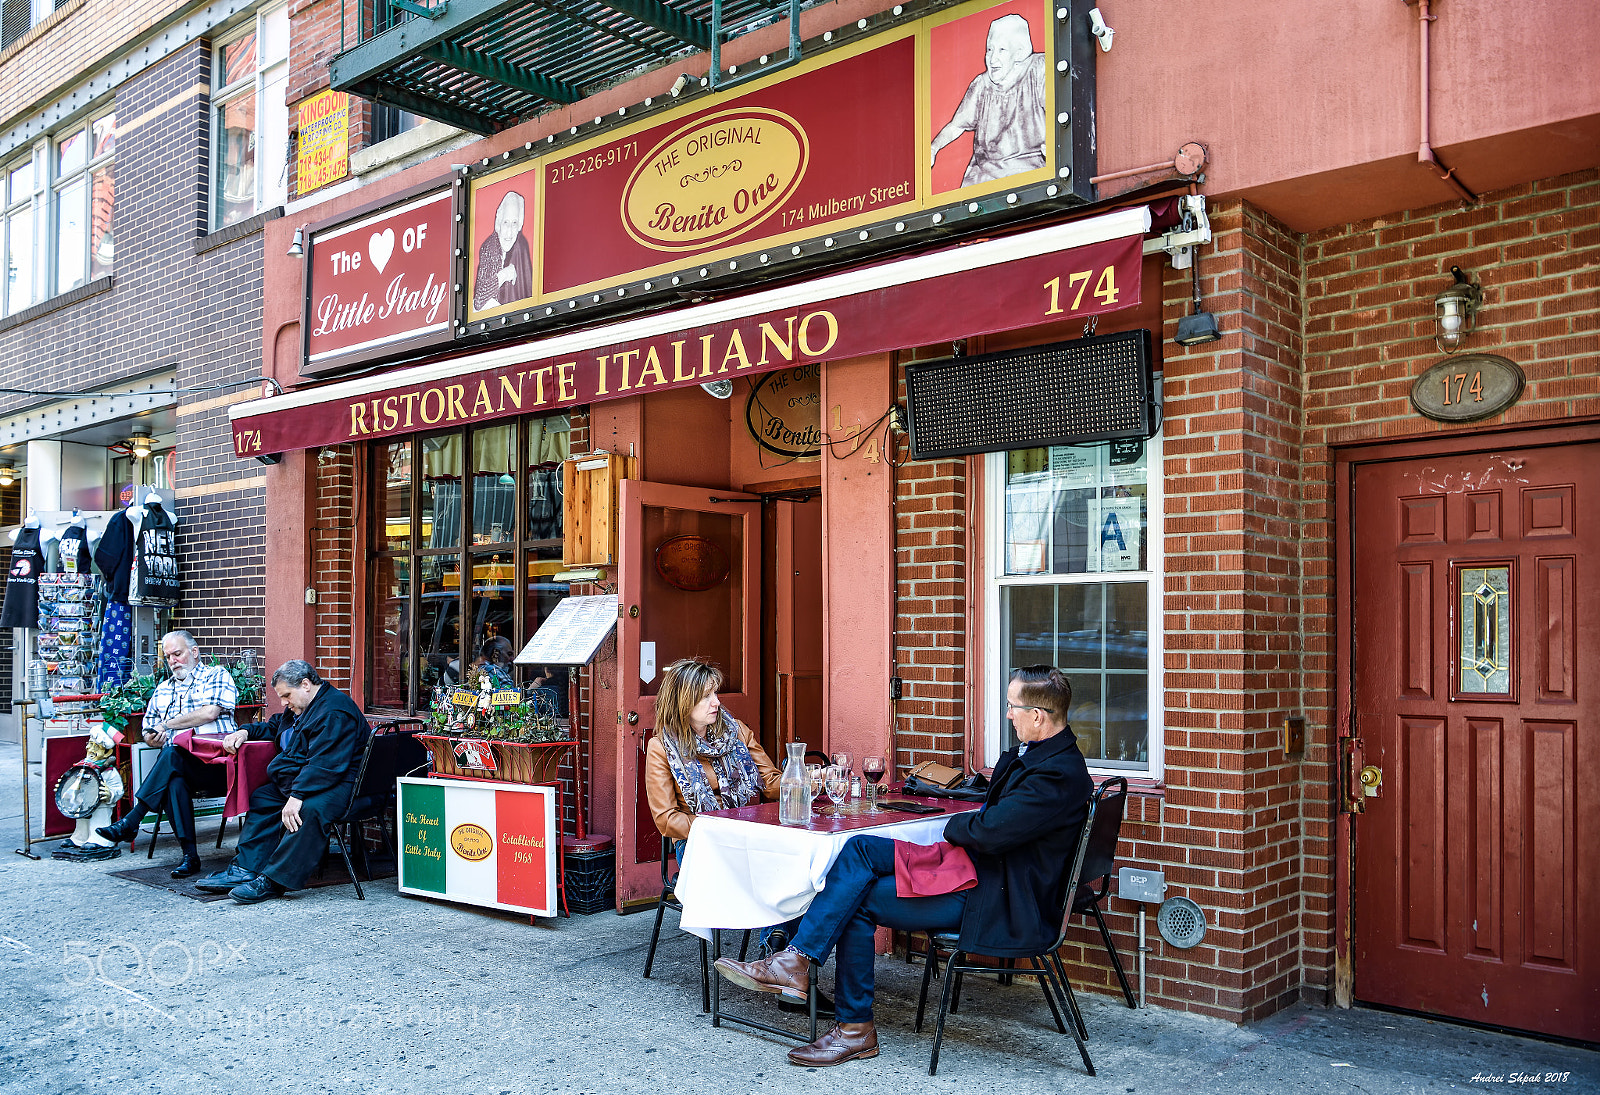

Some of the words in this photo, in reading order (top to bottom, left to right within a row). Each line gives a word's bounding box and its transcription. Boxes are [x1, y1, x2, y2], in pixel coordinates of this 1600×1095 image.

[300, 91, 347, 127] KINGDOM
[300, 109, 347, 137] WATERPROOFING
[307, 125, 333, 143] ROOFING
[551, 141, 639, 185] 212-226-9171
[655, 152, 681, 177] THE
[686, 126, 762, 157] ORIGINAL
[648, 202, 729, 233] Benito
[733, 172, 780, 215] One
[781, 210, 805, 228] 174
[808, 193, 868, 221] Mulberry
[869, 180, 910, 204] Street
[330, 251, 362, 276] The
[402, 222, 428, 254] OF
[312, 293, 376, 337] Little
[378, 273, 448, 324] Italy
[1043, 265, 1120, 316] 174
[349, 361, 578, 437] RISTORANTE
[595, 310, 839, 396] ITALIANO
[768, 376, 789, 396] THE
[1442, 371, 1484, 406] 174
[235, 430, 262, 454] 174
[764, 417, 822, 447] Benito
[1095, 513, 1127, 550] A
[456, 693, 475, 703] NICK
[494, 692, 518, 702] JAMES
[405, 813, 418, 825] The
[419, 814, 440, 826] Heart
[418, 829, 428, 843] Of
[502, 832, 545, 849] Established
[404, 844, 422, 856] Little
[422, 845, 442, 861] Italy
[513, 851, 534, 864] 1968
